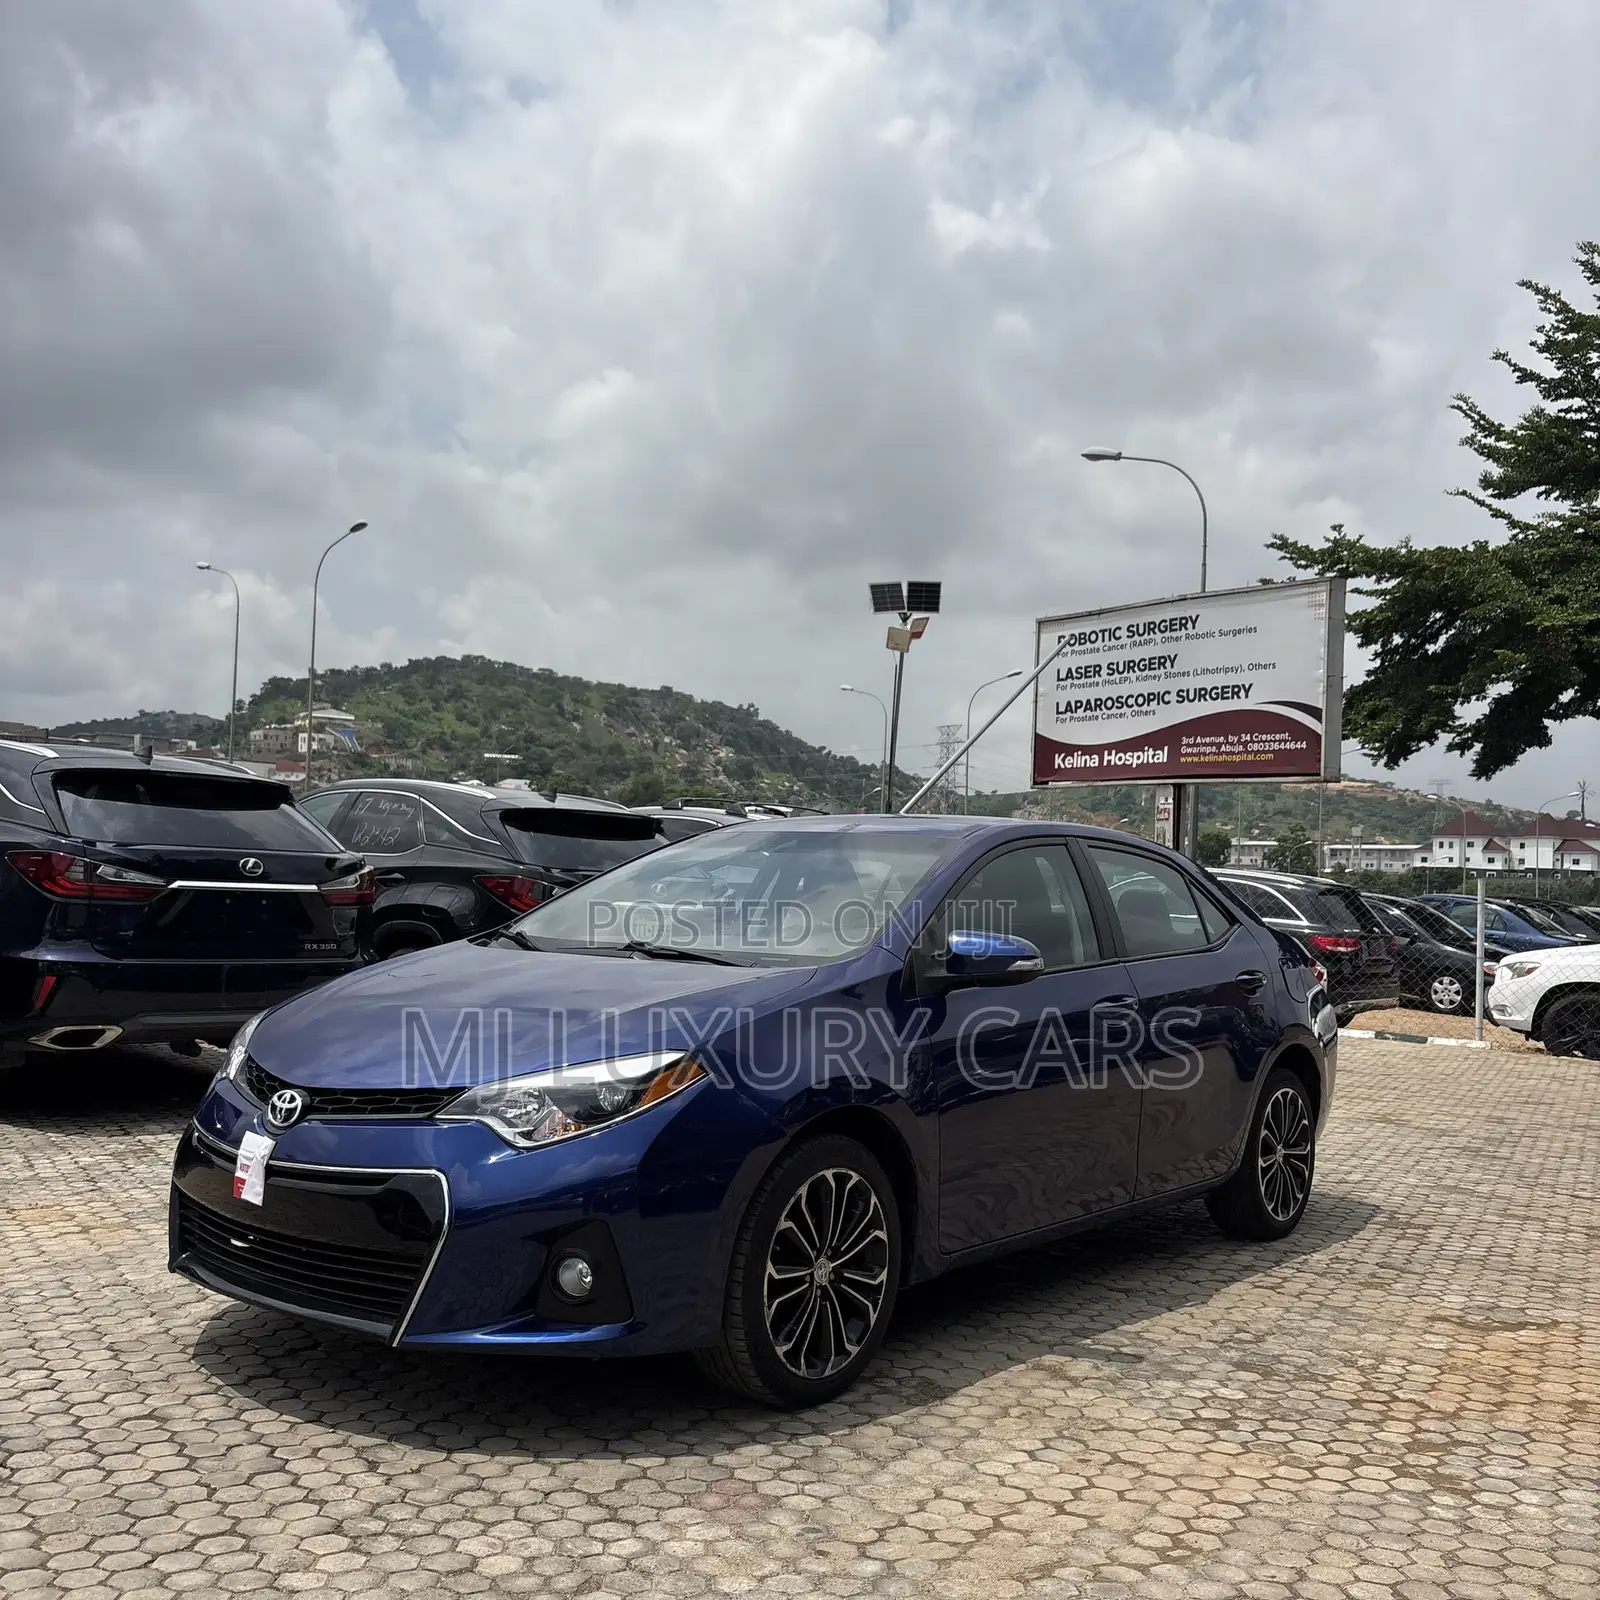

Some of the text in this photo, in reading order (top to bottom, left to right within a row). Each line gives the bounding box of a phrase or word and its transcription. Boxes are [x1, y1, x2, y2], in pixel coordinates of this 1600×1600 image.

[1057, 614, 1200, 648] ROBOTIC SURGERY
[1057, 625, 1258, 658] For Prostate Cancer (RARP), Other Robotic Surgeries
[1056, 653, 1179, 682] LASER SURGERY
[1070, 681, 1100, 690] Prostate
[1101, 677, 1134, 688] (HoLEP),
[1135, 673, 1162, 684] Kidney
[1163, 670, 1191, 680] Stones
[1192, 664, 1246, 678] (Lithotripsy),
[1247, 661, 1277, 671] Others
[1055, 683, 1254, 716] LAPAROSCOPIC SURGERY
[1055, 708, 1156, 724] For Prostate Cancer, Others
[1181, 732, 1291, 744] 3rd Avenue, by 34 Crescent,
[1247, 741, 1307, 751] 08033644644
[1054, 745, 1169, 769] Kelina Hospital
[1180, 752, 1274, 763] www.kelinahospital.com
